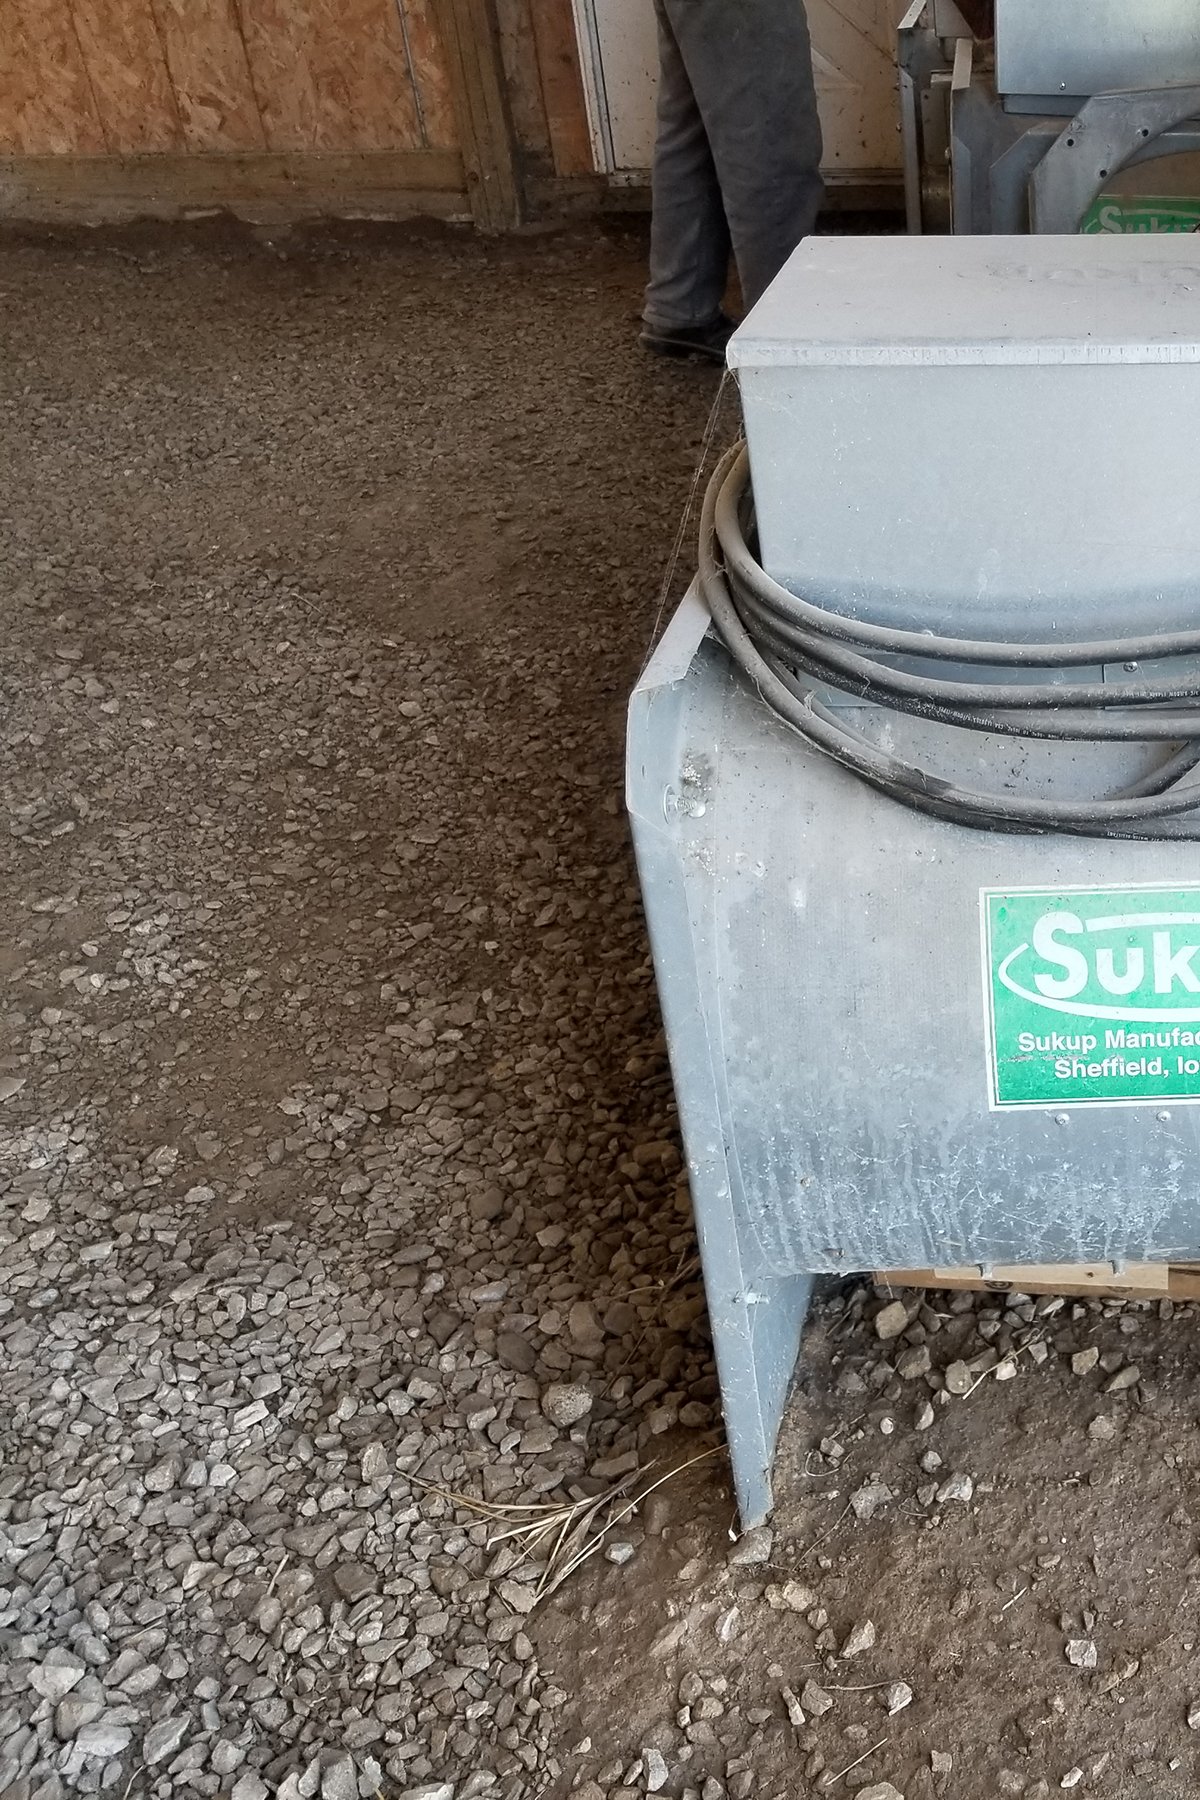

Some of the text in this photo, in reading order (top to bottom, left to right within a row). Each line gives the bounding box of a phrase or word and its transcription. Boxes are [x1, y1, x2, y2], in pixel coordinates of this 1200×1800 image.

[1098, 205, 1195, 233] Suku
[1018, 1030, 1097, 1055] Sukup
[1054, 1055, 1170, 1080] Sheffield,
